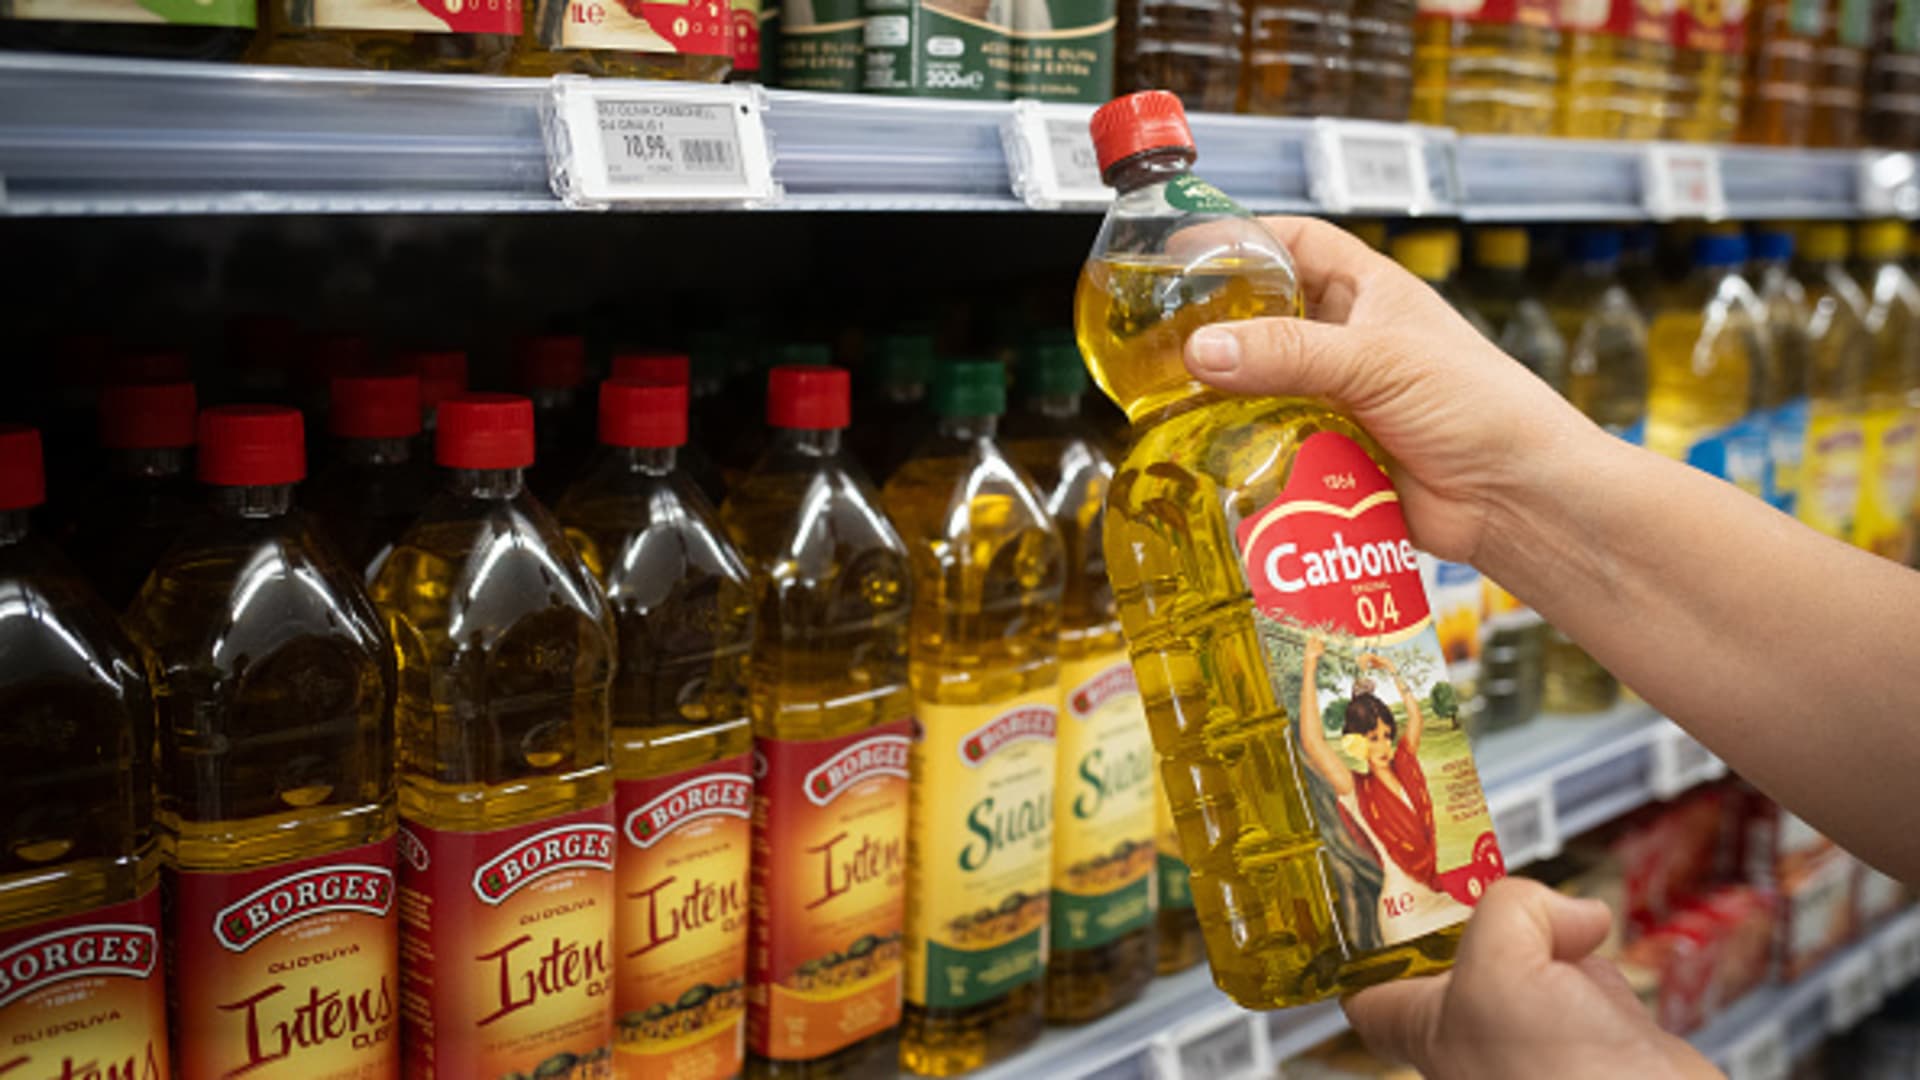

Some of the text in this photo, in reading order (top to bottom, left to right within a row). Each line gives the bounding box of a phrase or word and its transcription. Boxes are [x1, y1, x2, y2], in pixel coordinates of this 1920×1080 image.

[1357, 591, 1400, 632] 0,4
[650, 781, 747, 832] BORGES
[500, 833, 612, 884] BORGES
[246, 876, 380, 930] BORGES
